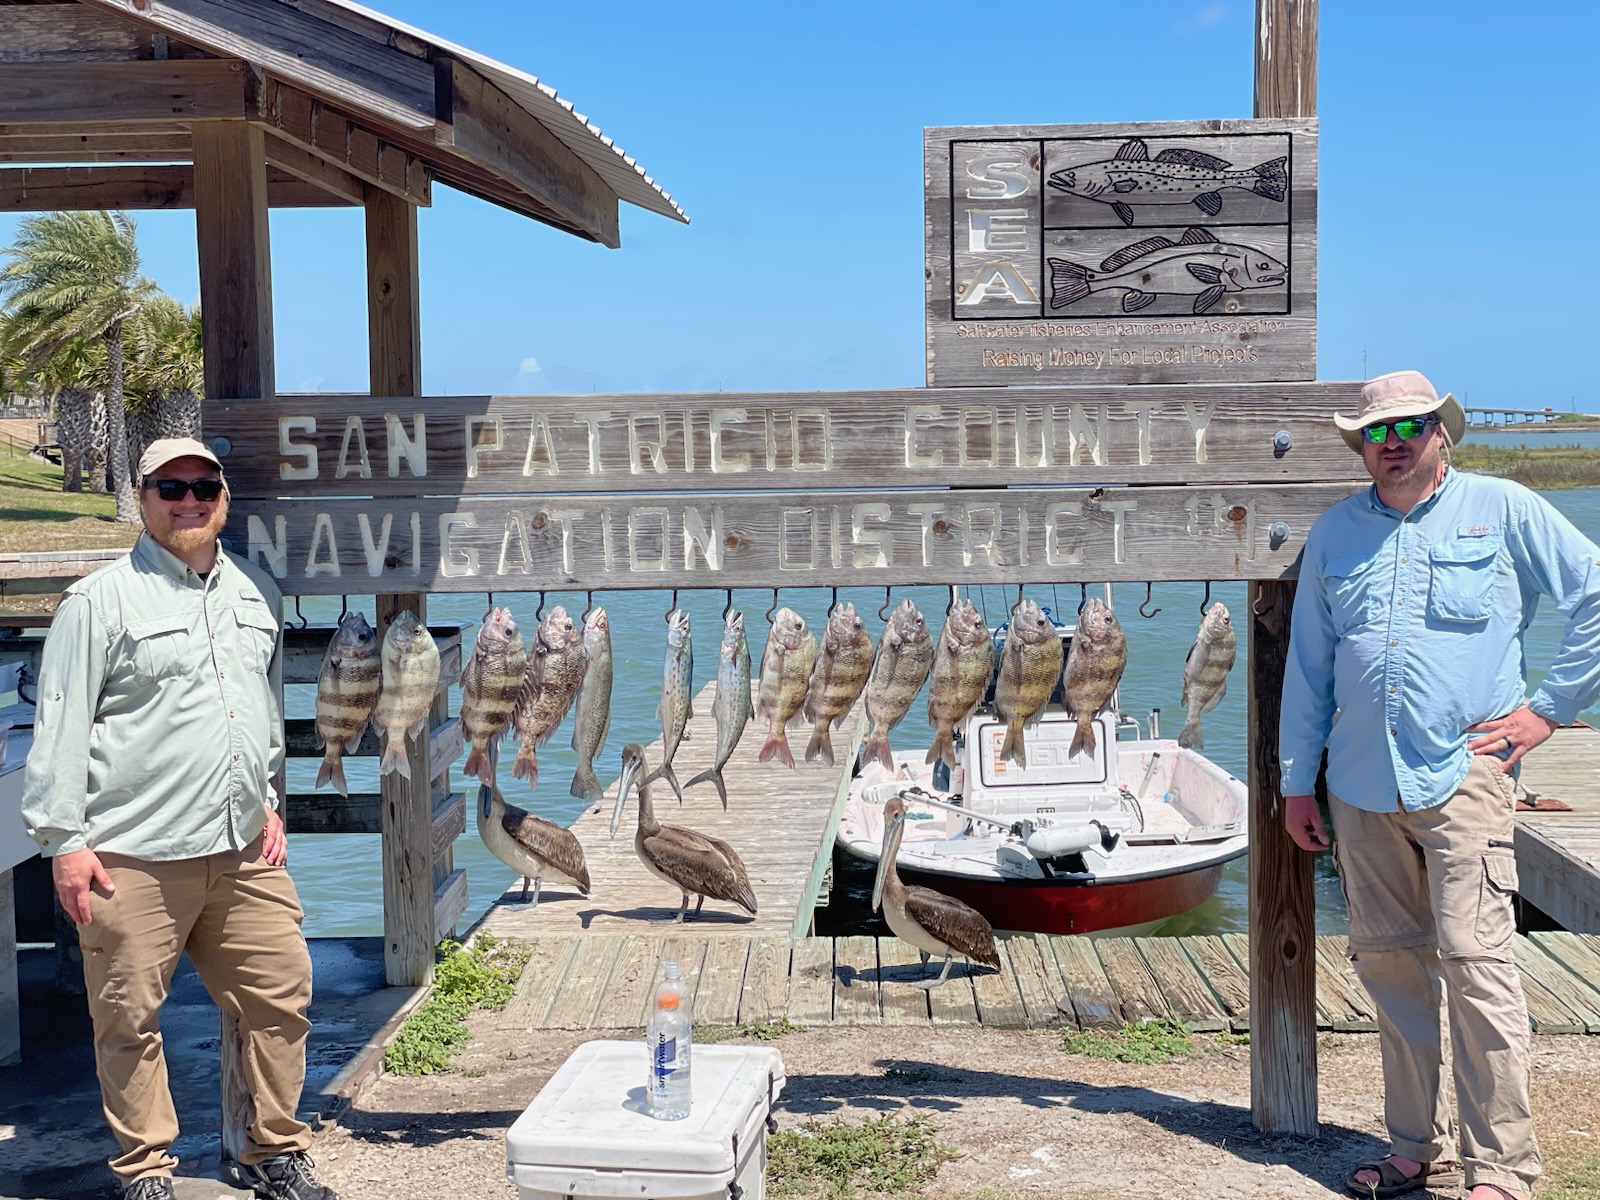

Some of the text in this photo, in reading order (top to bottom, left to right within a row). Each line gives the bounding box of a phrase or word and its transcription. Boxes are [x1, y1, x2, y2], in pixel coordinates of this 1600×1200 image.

[1096, 320, 1197, 337] Enhancement
[1200, 319, 1286, 334] Association
[981, 345, 1259, 371] Raising Money For Local Projects
[278, 400, 1219, 481] SAN PATRICIO COUNTY
[247, 507, 725, 577] NAVIGATION
[778, 501, 1139, 570] DISTRICT
